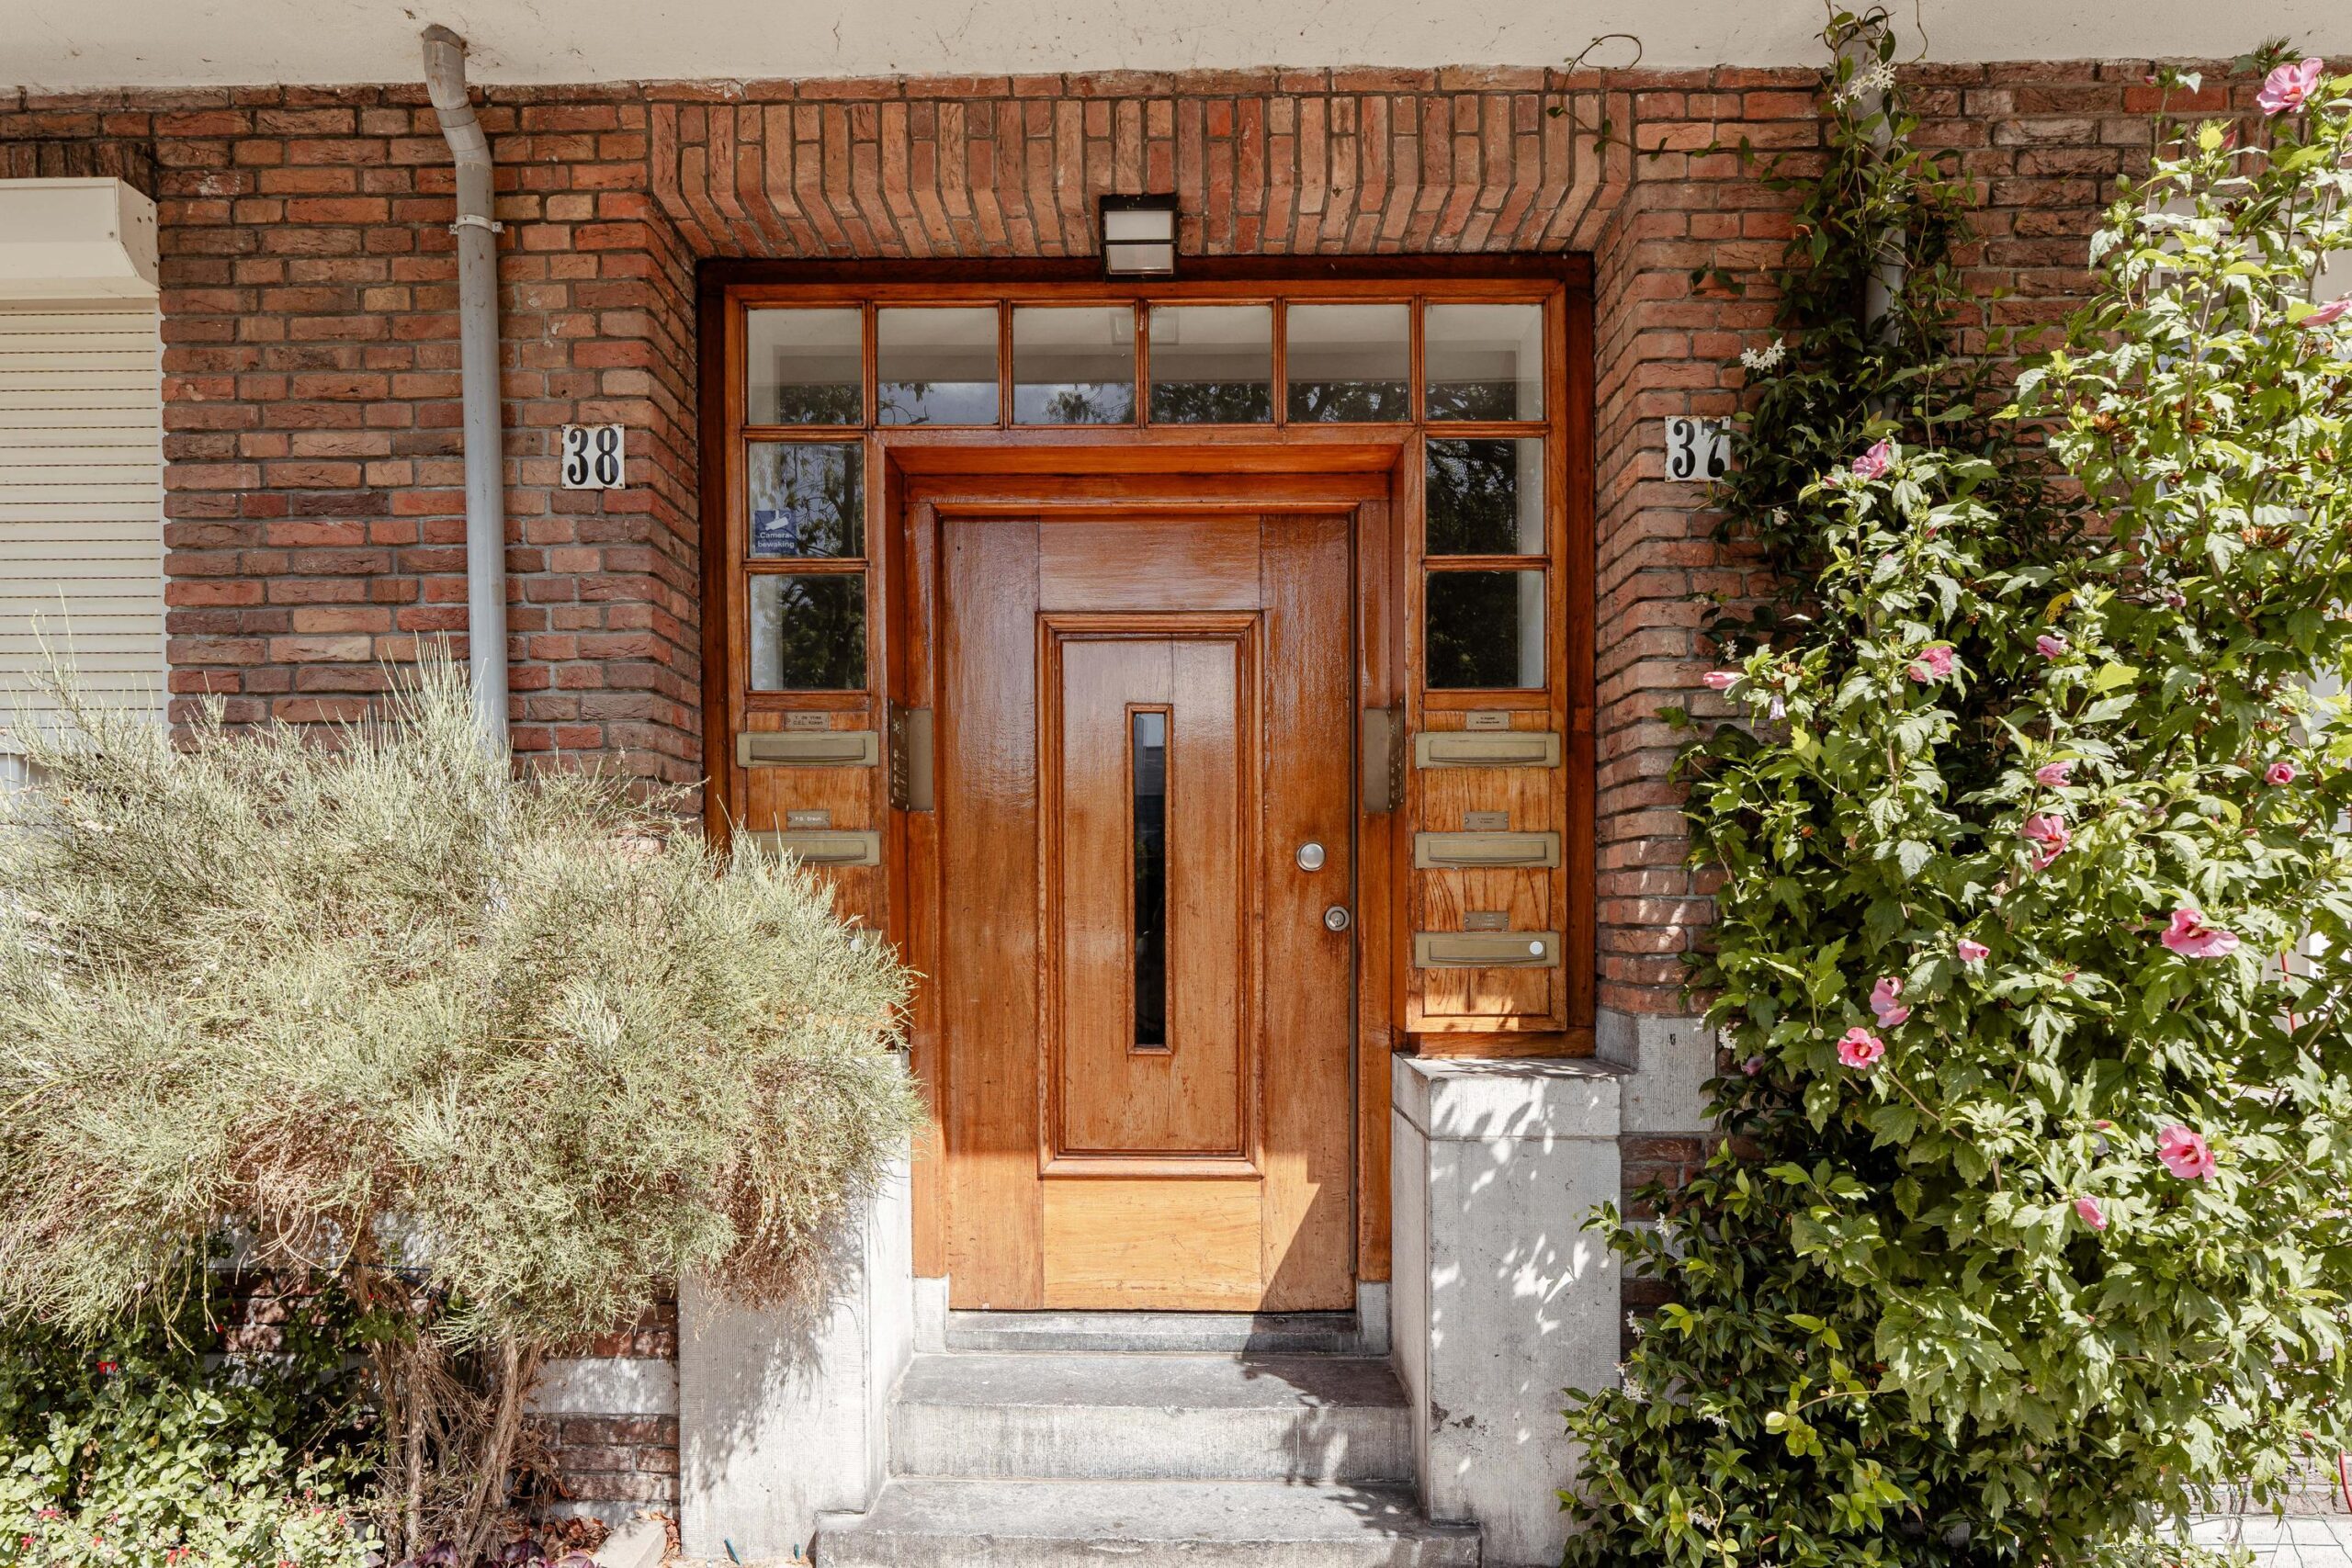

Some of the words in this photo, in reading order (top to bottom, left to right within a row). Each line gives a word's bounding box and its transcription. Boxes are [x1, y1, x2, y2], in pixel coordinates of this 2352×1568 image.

[568, 427, 618, 485] 38
[1672, 419, 1725, 478] 37
[757, 540, 795, 548] bewaking
